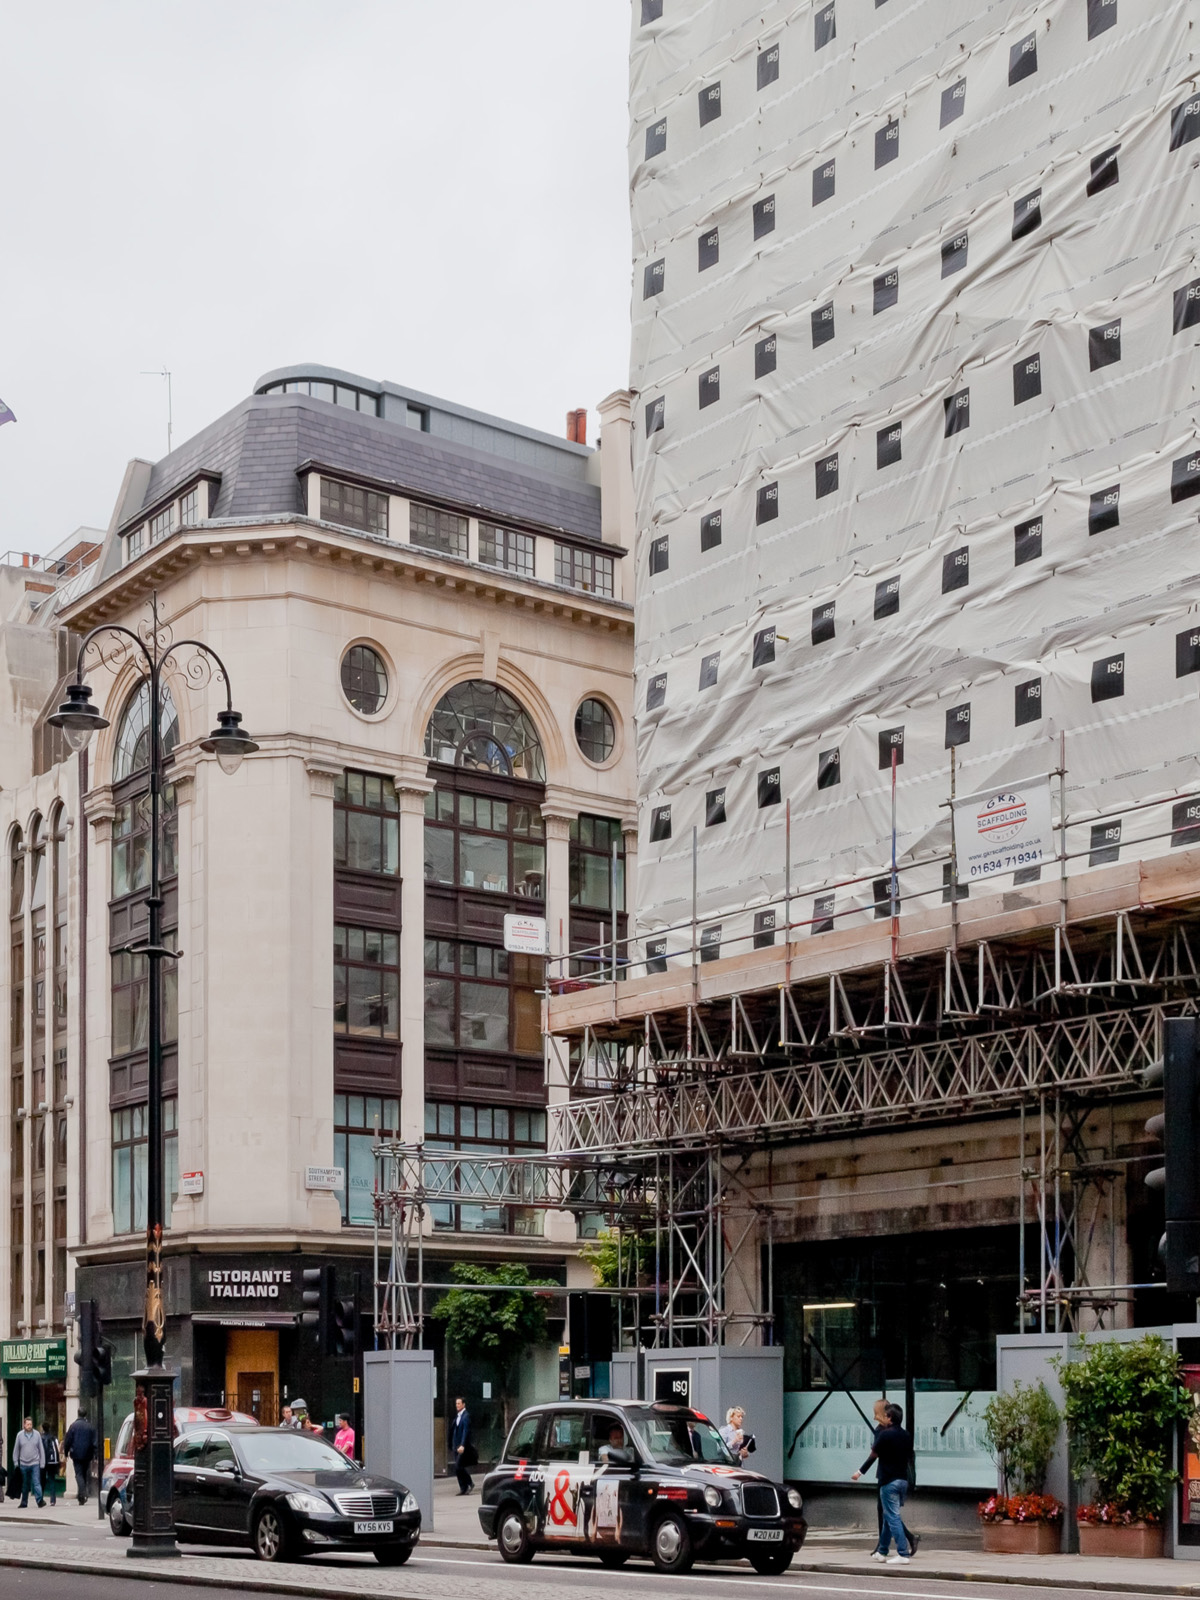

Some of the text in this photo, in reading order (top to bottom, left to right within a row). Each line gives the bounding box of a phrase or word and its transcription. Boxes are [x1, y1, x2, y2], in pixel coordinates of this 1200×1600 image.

[824, 8, 835, 22] isg
[1022, 38, 1036, 53] isg
[767, 50, 778, 63] isg
[709, 88, 720, 101] isg
[953, 84, 965, 99] isg
[1185, 101, 1200, 116] isg
[656, 124, 666, 135] isg
[886, 127, 899, 140] isg
[823, 166, 834, 178] isg
[764, 201, 775, 213] isg
[1027, 197, 1040, 210] isg
[708, 234, 719, 246] isg
[954, 235, 968, 249] isg
[653, 264, 664, 275] isg
[885, 274, 898, 286] isg
[822, 307, 833, 320] isg
[1104, 326, 1121, 340] isg
[765, 341, 775, 353] isg
[1026, 360, 1039, 374] isg
[708, 371, 718, 383] isg
[956, 394, 968, 408] isg
[889, 429, 901, 442] isg
[826, 459, 838, 472] isg
[766, 488, 777, 500] isg
[1104, 491, 1119, 505] isg
[710, 515, 721, 527] isg
[1028, 523, 1042, 537] isg
[659, 541, 668, 552] isg
[954, 553, 968, 566] isg
[887, 581, 899, 594] isg
[823, 607, 834, 619] isg
[764, 632, 775, 643] isg
[1190, 635, 1200, 646] is
[1108, 661, 1124, 675] isg
[656, 679, 666, 690] isg
[1028, 685, 1041, 698] isg
[957, 710, 969, 722] isg
[891, 732, 903, 744] isg
[768, 773, 780, 785] isg
[986, 794, 1016, 810] GKR
[660, 810, 670, 821] isg
[977, 808, 1027, 828] SCAFFOLDING
[988, 825, 1019, 840] LIMITED
[1105, 827, 1120, 840] isg
[968, 839, 1042, 861] www.gkrscaffolding.co.uk
[970, 849, 1043, 876] 01634 719341
[823, 900, 834, 911] isg
[763, 915, 774, 927] isg
[710, 931, 721, 942] isg
[656, 944, 666, 954] isg
[308, 1167, 342, 1176] SOUTHAMPTON
[208, 1270, 292, 1283] ISTORANTE
[210, 1285, 279, 1298] ITALIANO
[672, 1380, 688, 1396] isg
[357, 1522, 391, 1532] KY56 KVS
